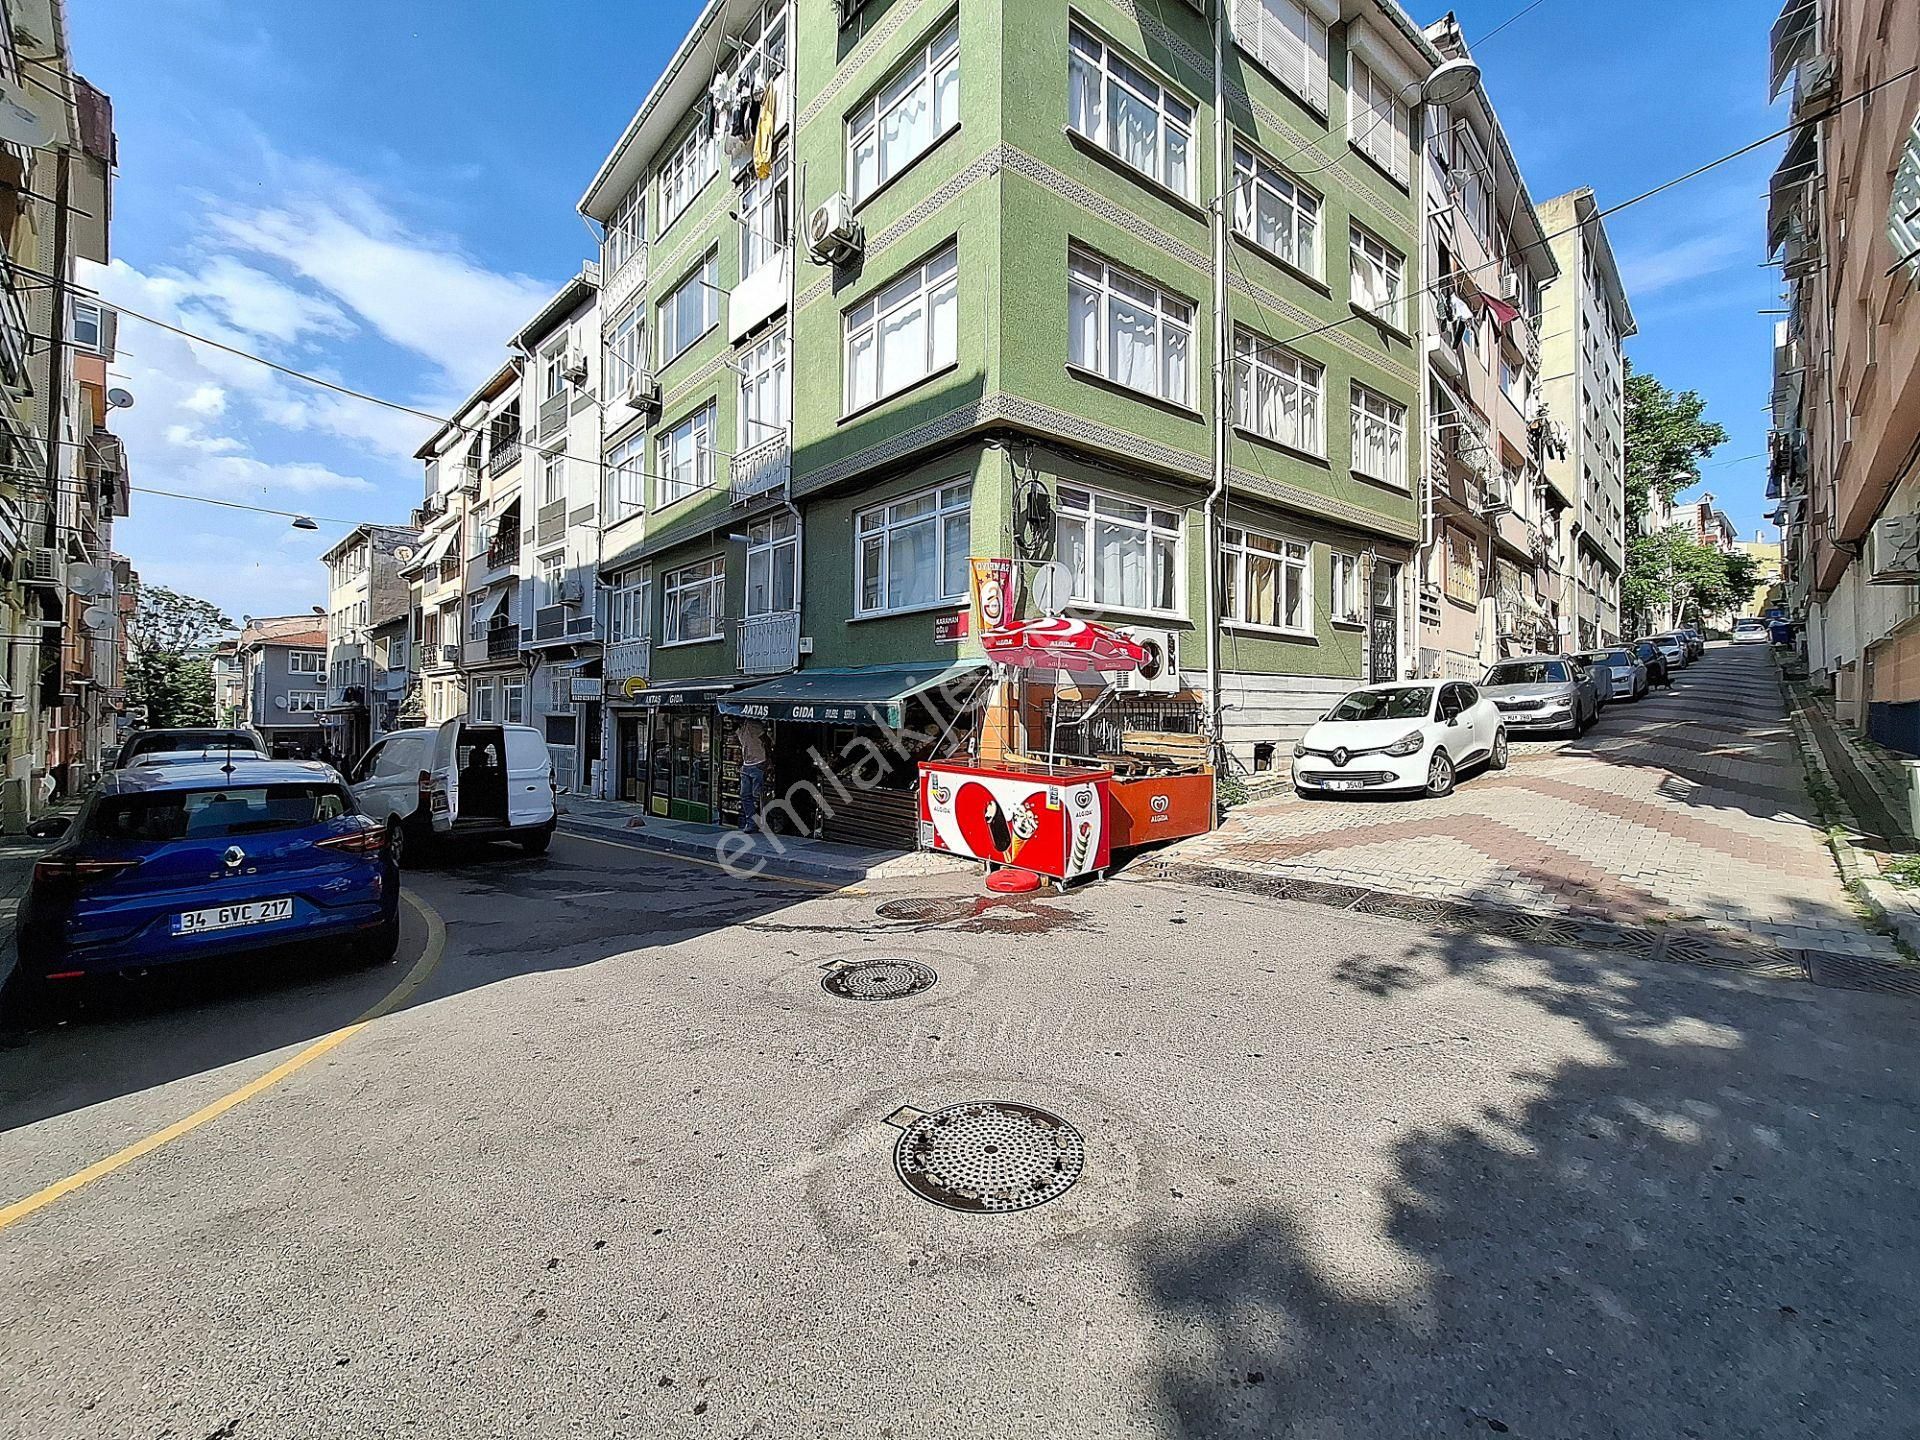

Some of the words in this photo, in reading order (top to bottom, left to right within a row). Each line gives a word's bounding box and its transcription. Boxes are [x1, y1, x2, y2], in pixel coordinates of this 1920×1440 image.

[936, 616, 959, 626] KARAMAN
[669, 694, 684, 704] GIDA
[792, 706, 814, 719] GIDA
[1075, 810, 1093, 818] ALGIDA
[1150, 814, 1169, 823] ALGIDA
[209, 867, 257, 878] CLIO
[183, 913, 207, 929] 34
[218, 906, 252, 924] GVC
[260, 900, 289, 918] 217
